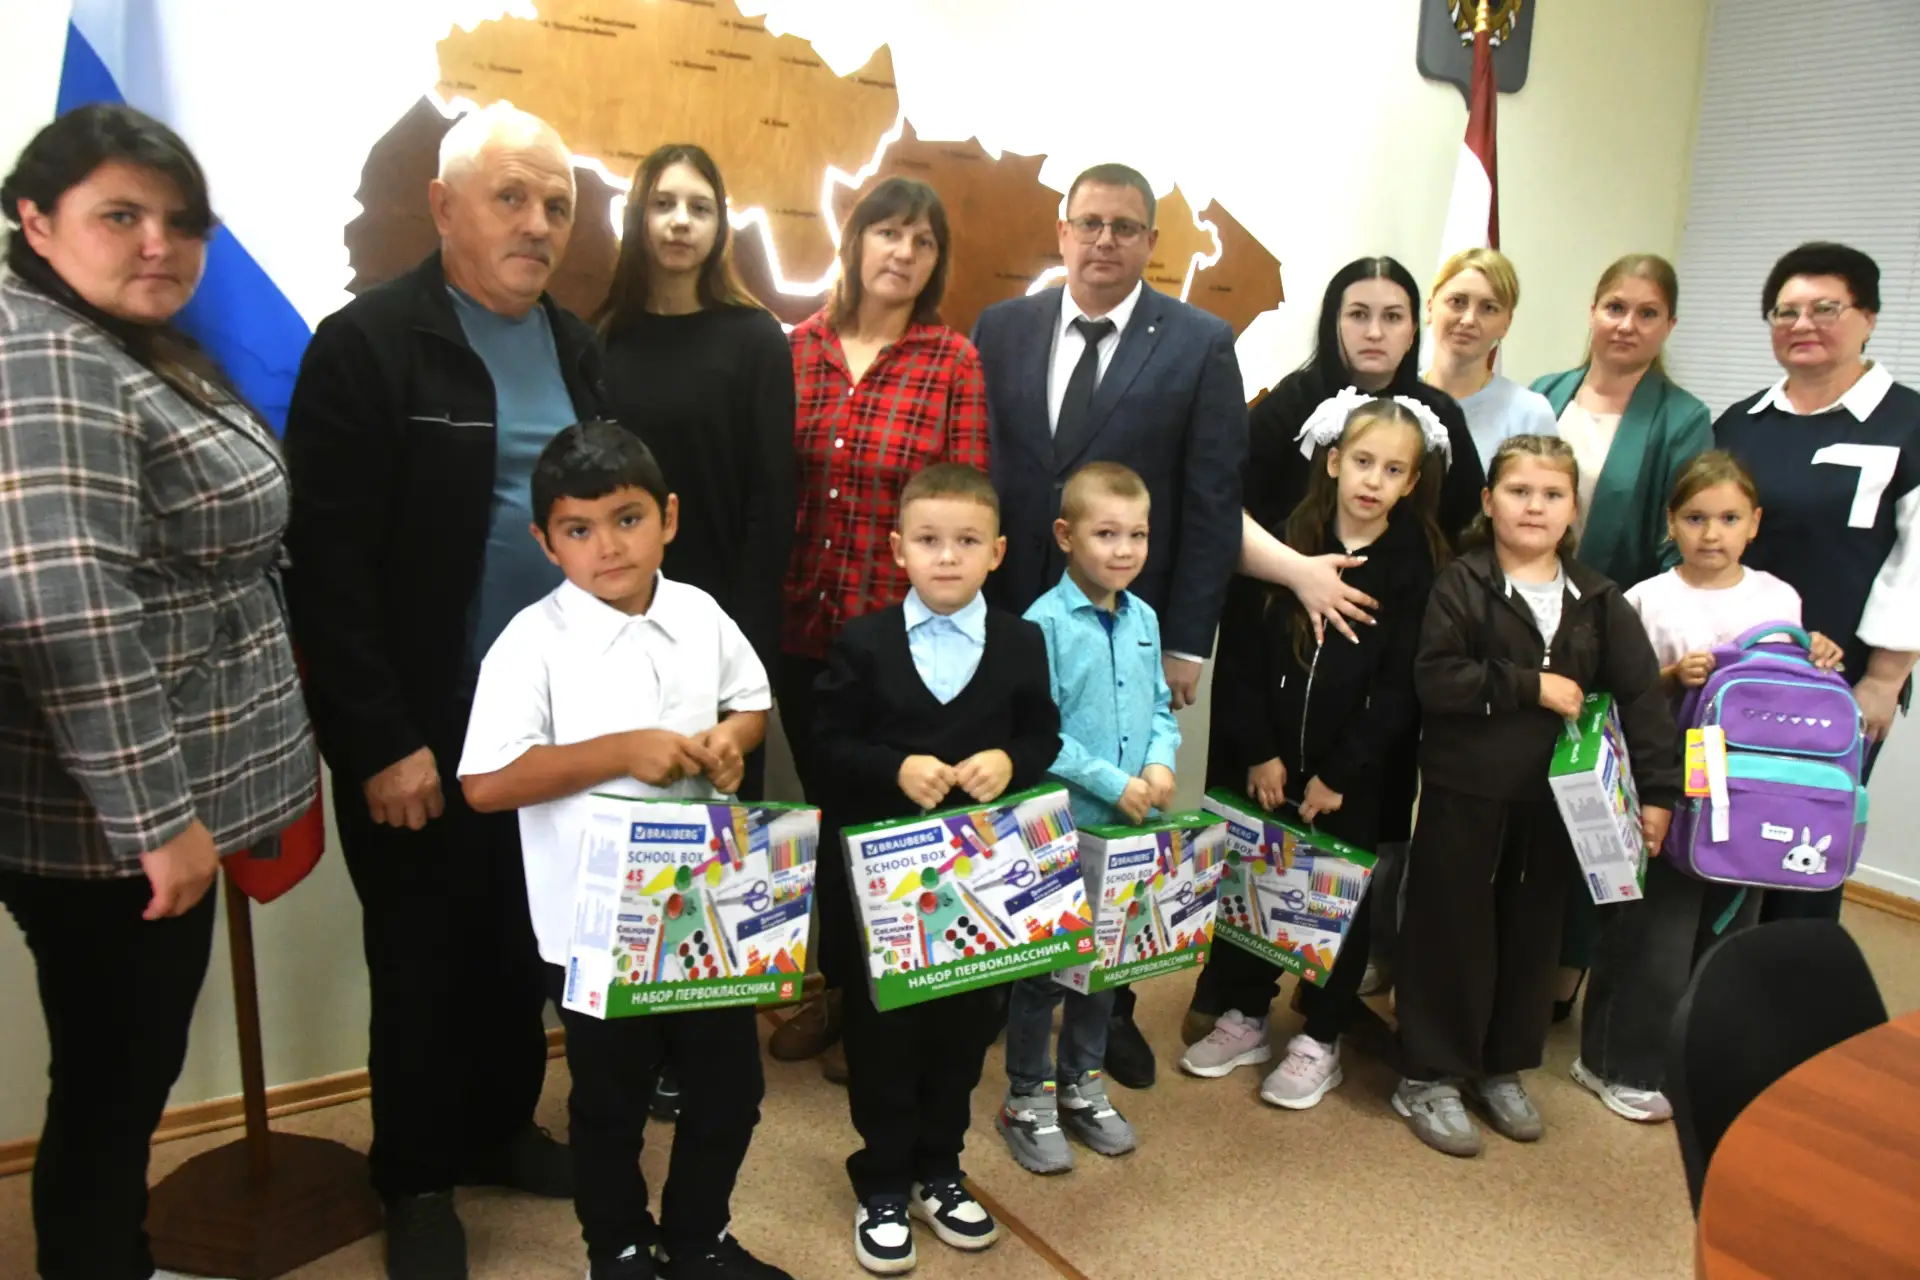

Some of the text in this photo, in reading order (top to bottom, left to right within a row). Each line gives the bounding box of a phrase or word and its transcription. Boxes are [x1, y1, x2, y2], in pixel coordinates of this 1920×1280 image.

[1811, 443, 1901, 529] 7
[646, 827, 699, 841] BRAUBERG
[878, 832, 936, 852] BRAUBERG
[1233, 842, 1253, 855] BOX
[627, 851, 704, 864] SCHOOL BOX
[865, 850, 946, 875] SCHOOL BOX
[1117, 852, 1150, 866] BRAUBERG
[626, 868, 644, 882] 45
[1105, 872, 1136, 885] SCHOOL
[869, 877, 886, 890] 45
[1105, 887, 1115, 899] 45
[1078, 937, 1091, 948] 45
[1215, 922, 1300, 969] ПЕРВОКЛАССНИКА
[908, 966, 951, 989] НАБОР
[955, 941, 1071, 977] ПЕРВОКЛАССНИКА
[1104, 968, 1129, 983] НАБОР
[1130, 952, 1194, 975] ПЕРВОКЛАССНИКА
[631, 990, 674, 1005] НАБОР
[675, 981, 777, 1001] ПЕРВОКЛАССНИКА
